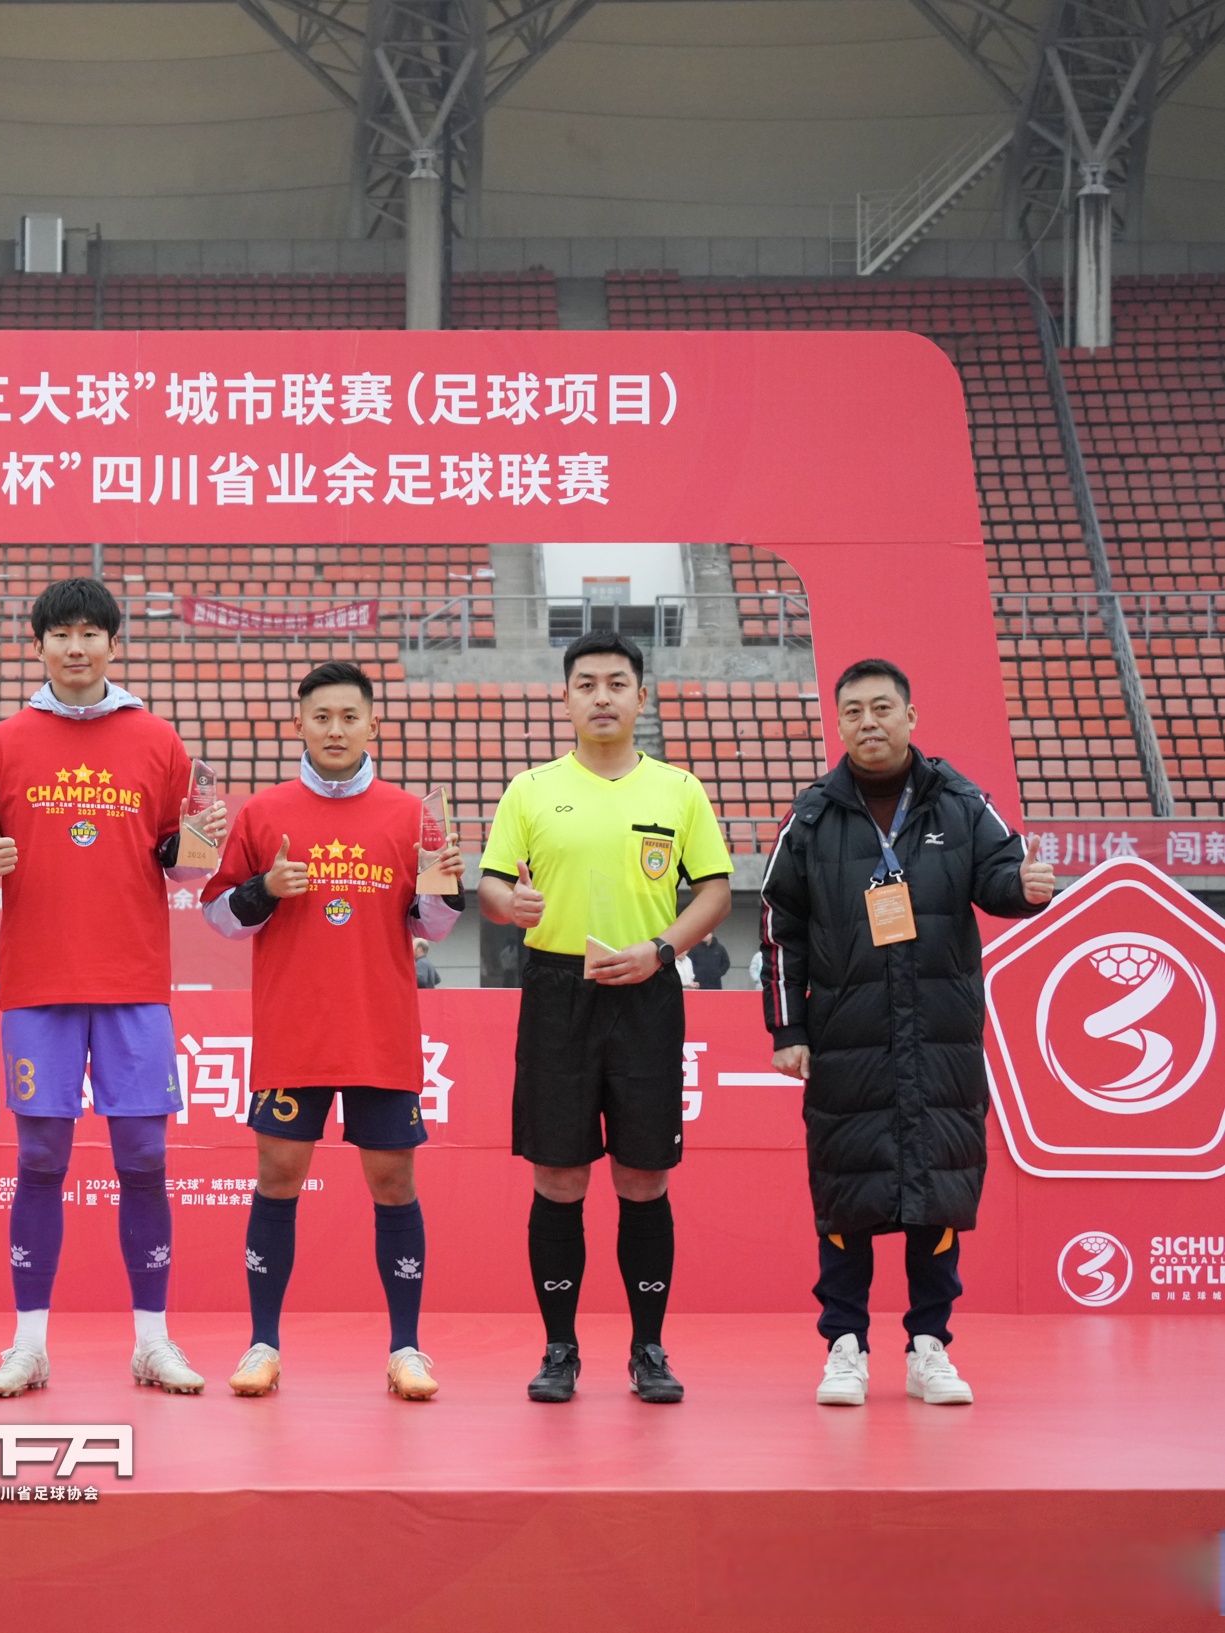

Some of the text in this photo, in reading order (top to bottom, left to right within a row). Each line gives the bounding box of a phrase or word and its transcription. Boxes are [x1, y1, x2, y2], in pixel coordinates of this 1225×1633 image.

[645, 840, 670, 849] REFEREE
[187, 850, 207, 859] 2024
[307, 861, 394, 884] AMPIONS
[357, 885, 376, 893] 2024
[1150, 1236, 1225, 1256] SICHU
[1150, 1256, 1225, 1265] FOOTBALL
[393, 1269, 422, 1279] KELME
[1150, 1265, 1202, 1285] CITY
